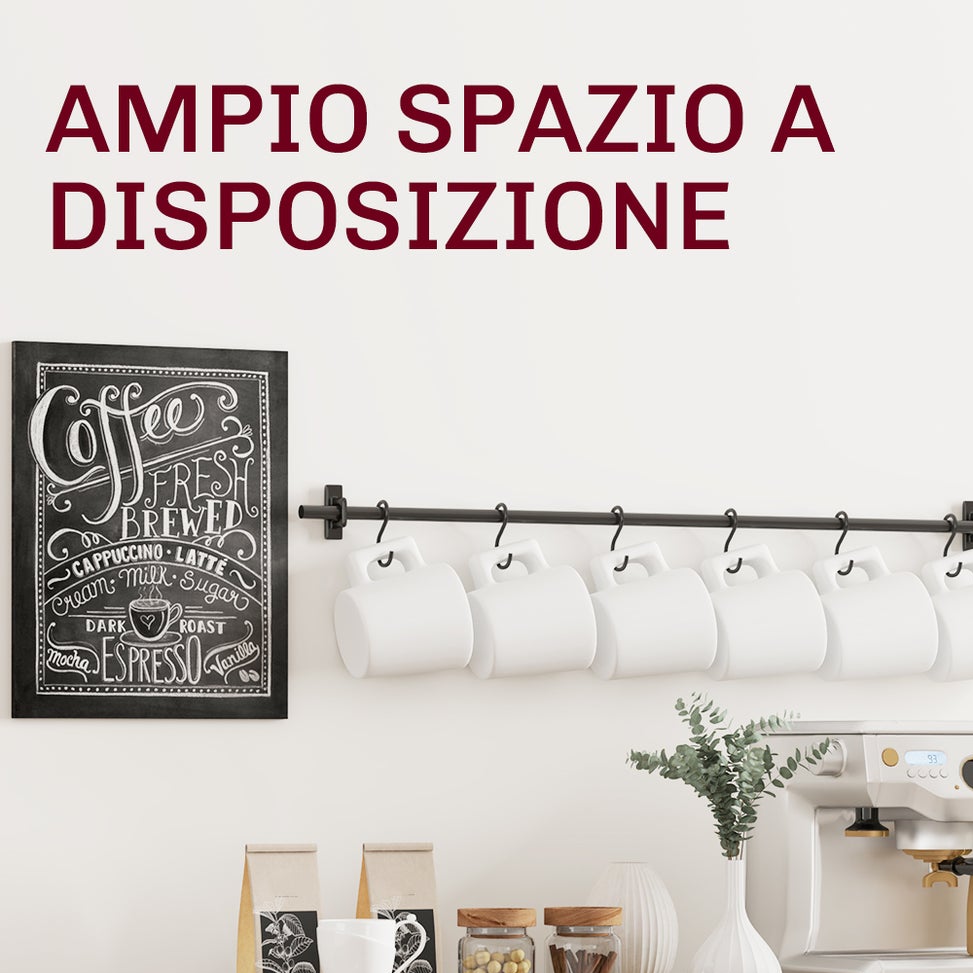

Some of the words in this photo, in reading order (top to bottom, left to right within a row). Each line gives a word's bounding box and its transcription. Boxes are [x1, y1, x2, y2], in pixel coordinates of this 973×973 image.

[28, 382, 238, 525] Coffee
[144, 450, 259, 518] FRESH
[120, 499, 243, 541] BREWED
[71, 543, 164, 578] CAPPUCCINO
[179, 570, 250, 611] Sugar
[86, 618, 127, 633] DARK
[179, 618, 227, 635] ROAST
[102, 634, 201, 685] ESPRESSO
[209, 641, 260, 677] Vanilla
